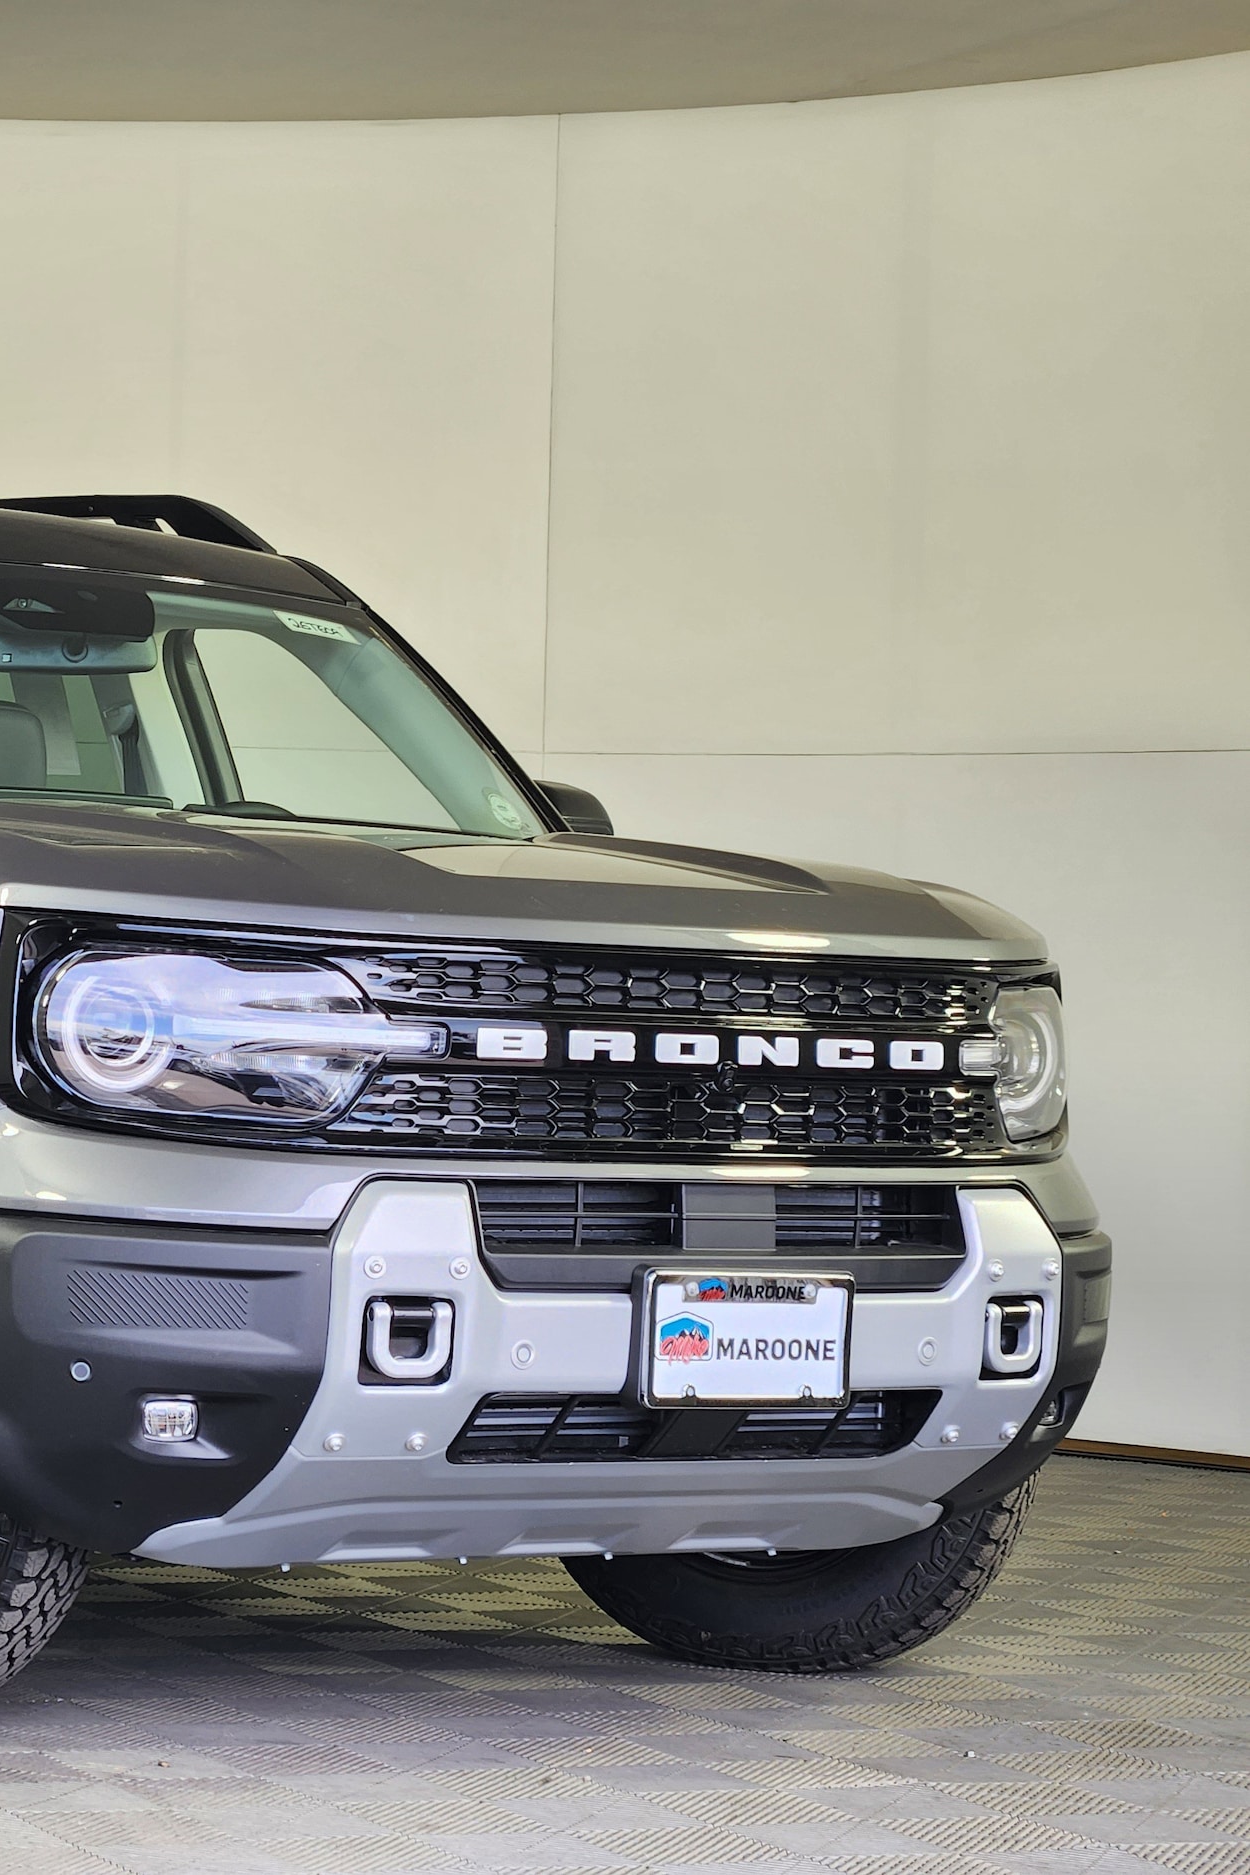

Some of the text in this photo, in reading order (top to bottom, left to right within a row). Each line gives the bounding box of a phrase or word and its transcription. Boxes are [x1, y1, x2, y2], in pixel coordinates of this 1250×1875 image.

[475, 1026, 945, 1072] BRONCO
[729, 1283, 806, 1300] MAROONE
[715, 1337, 837, 1361] MAROONE
